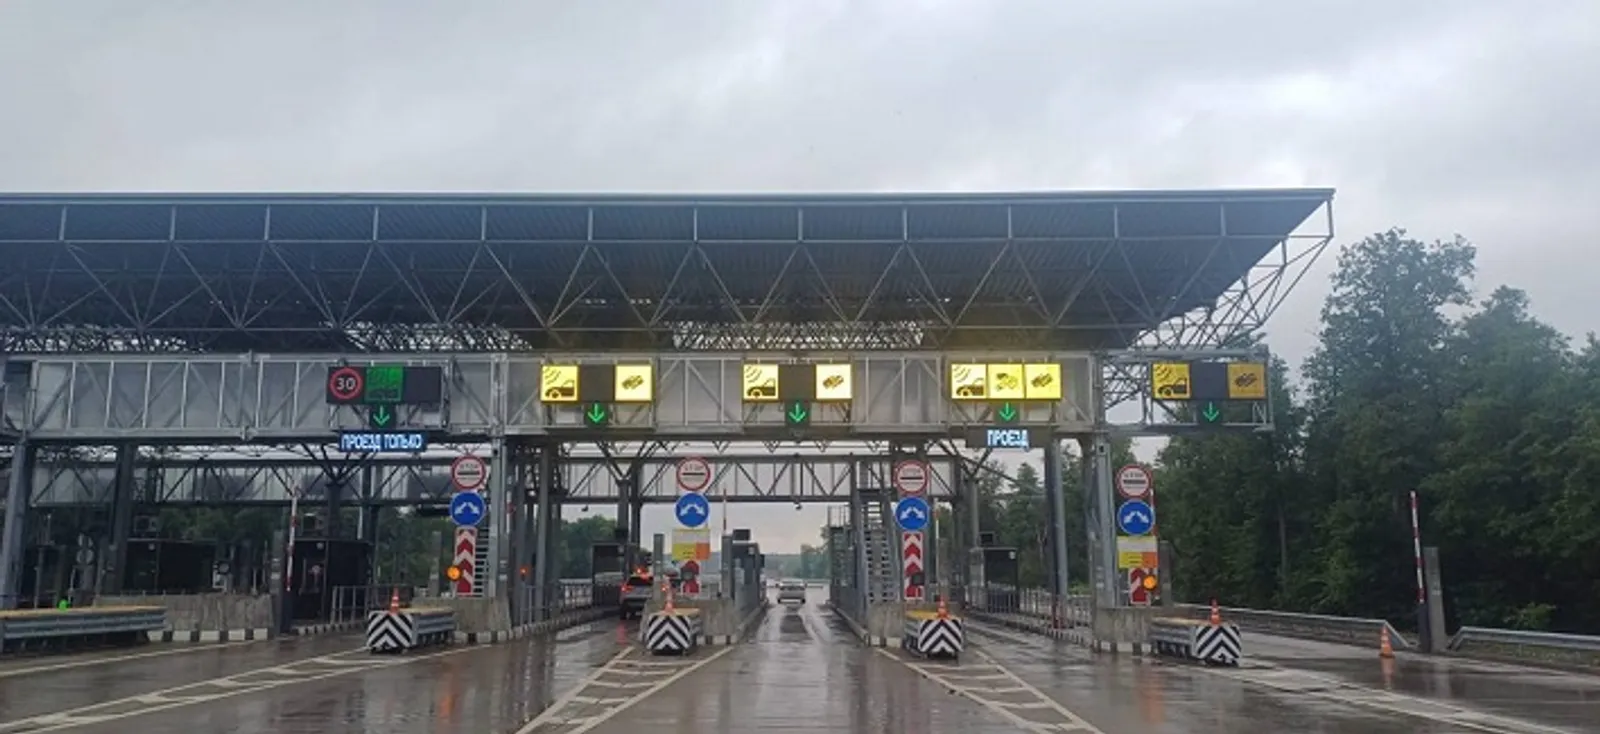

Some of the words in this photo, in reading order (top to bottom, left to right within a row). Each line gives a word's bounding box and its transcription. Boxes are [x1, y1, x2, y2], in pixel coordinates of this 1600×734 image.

[336, 377, 356, 390] 30
[341, 433, 381, 451] ПРОЕЗД
[384, 433, 421, 449] ТОЛЬКО
[987, 429, 1029, 451] ПРОЕЗД
